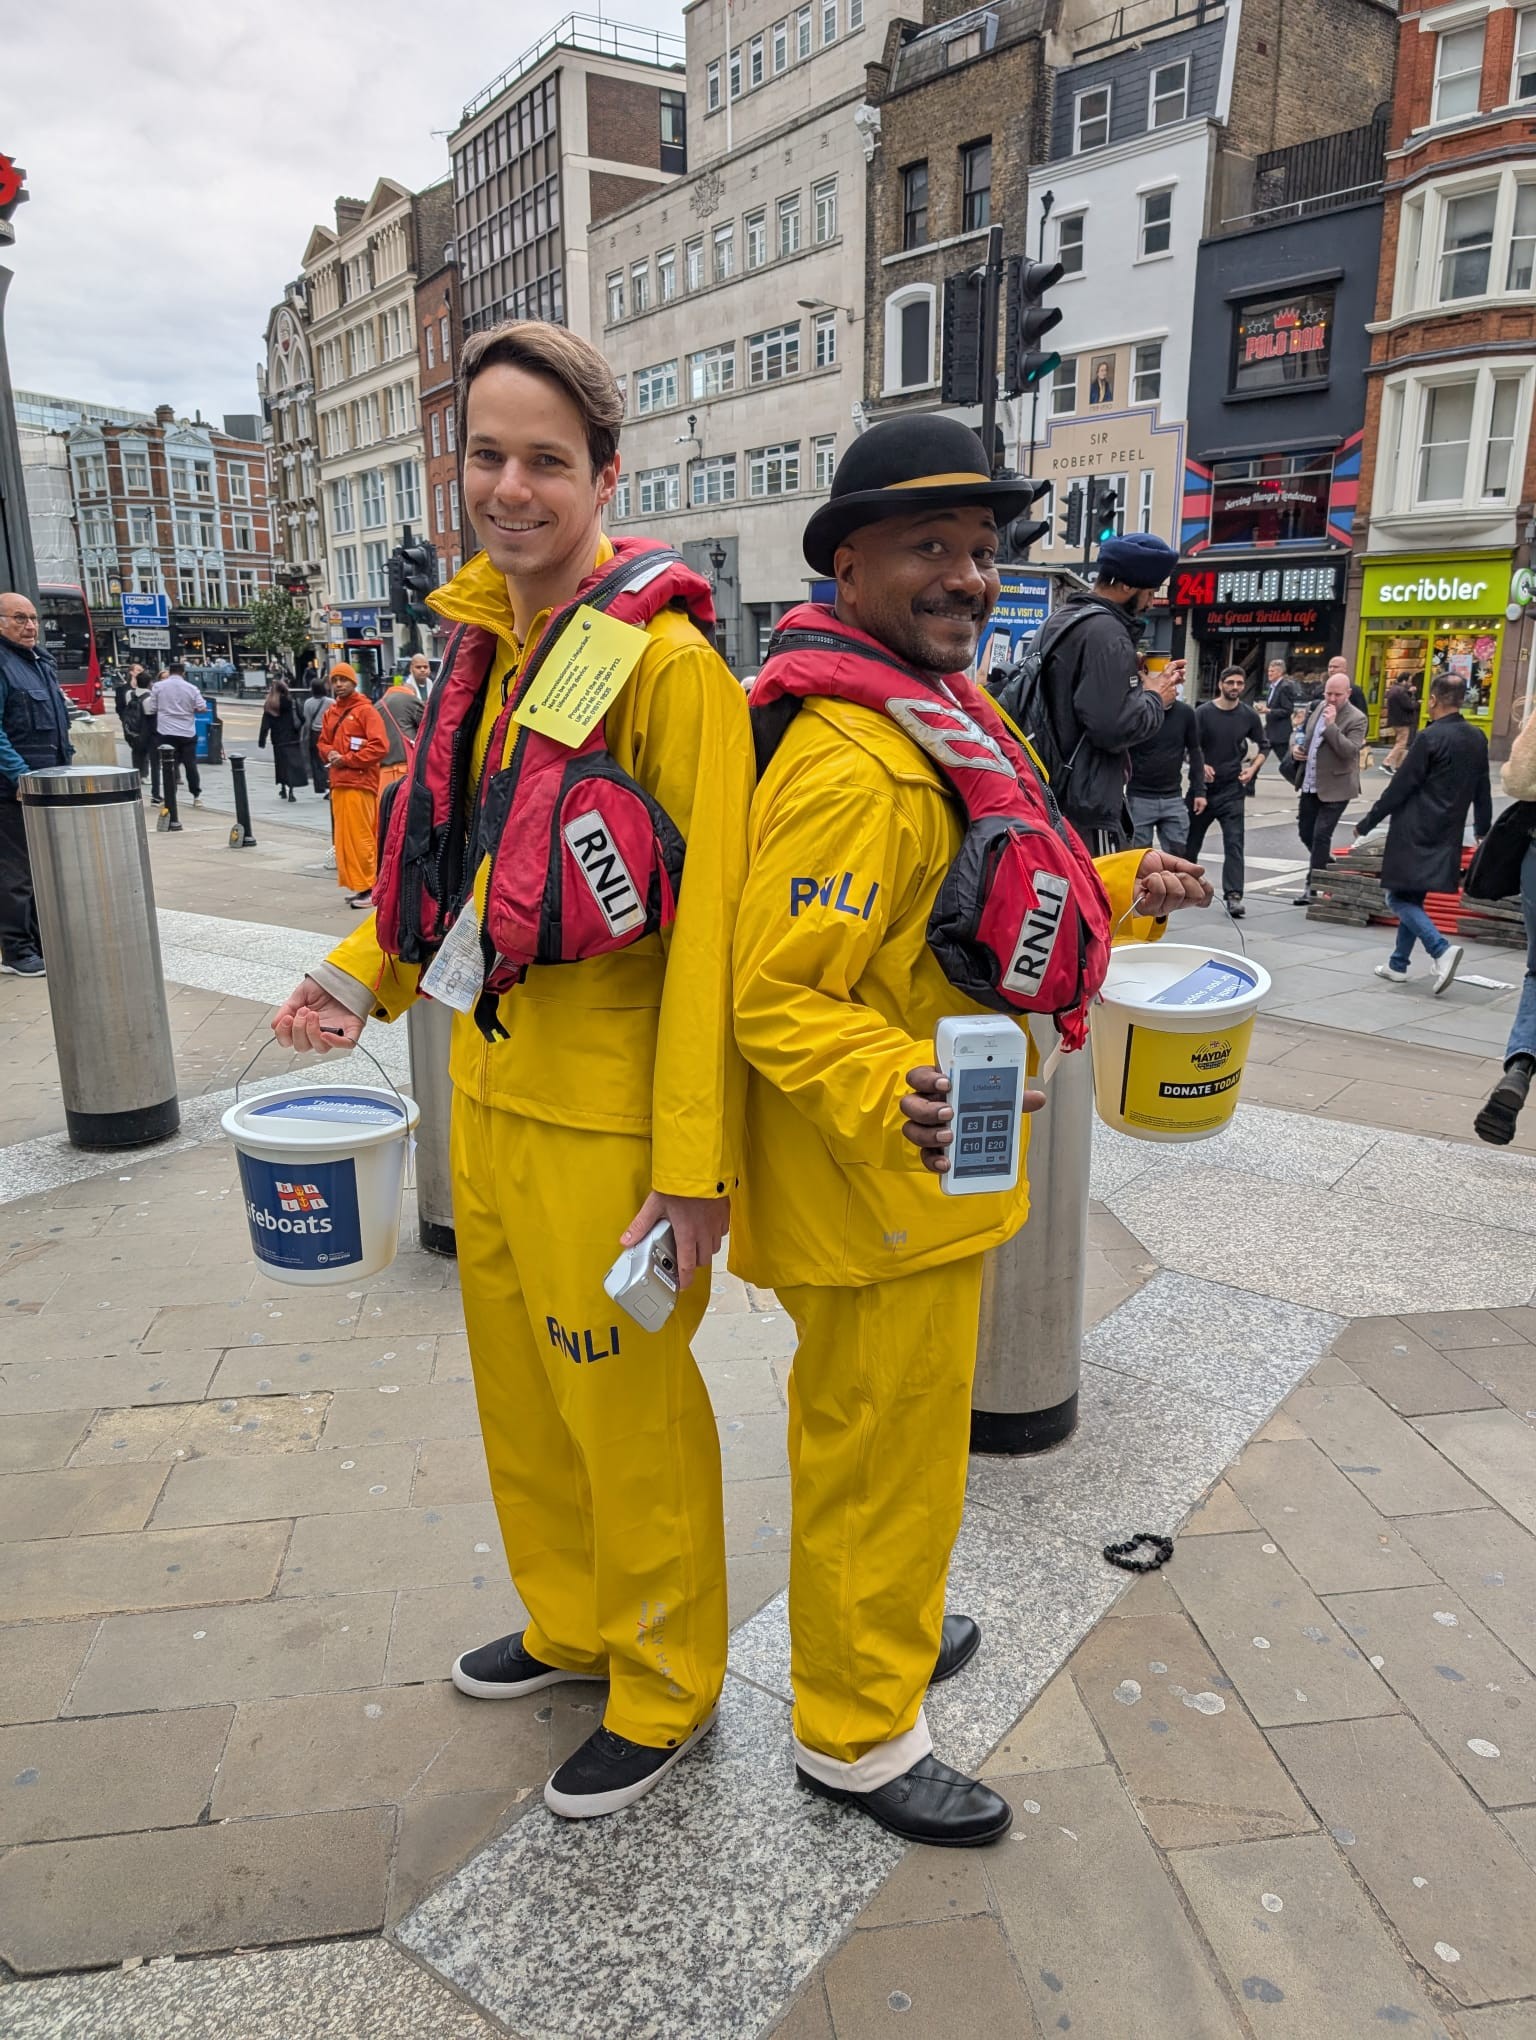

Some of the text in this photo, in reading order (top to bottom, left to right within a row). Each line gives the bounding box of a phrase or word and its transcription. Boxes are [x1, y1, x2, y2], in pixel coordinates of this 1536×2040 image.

[1244, 326, 1325, 361] POLO BAR
[1090, 432, 1109, 445] SIR
[1053, 449, 1145, 469] ROBERT PEEL
[1217, 570, 1280, 603] POLO
[1282, 567, 1336, 601] BAR
[1379, 577, 1488, 603] scribbler
[1017, 607, 1034, 617] VISIT
[1034, 608, 1044, 618] US
[1207, 611, 1222, 623] the
[1224, 610, 1253, 626] Great
[1256, 609, 1292, 623] British
[573, 828, 639, 922] RNLI
[1013, 888, 1064, 979] RNLI
[1190, 1047, 1232, 1063] MAYDAY
[1164, 1071, 1240, 1096] DONATE TODAY
[967, 1120, 1003, 1130] £3 £5
[963, 1140, 1004, 1152] £10 £20
[247, 1200, 333, 1234] ifeboats
[546, 1316, 620, 1364] RNLI
